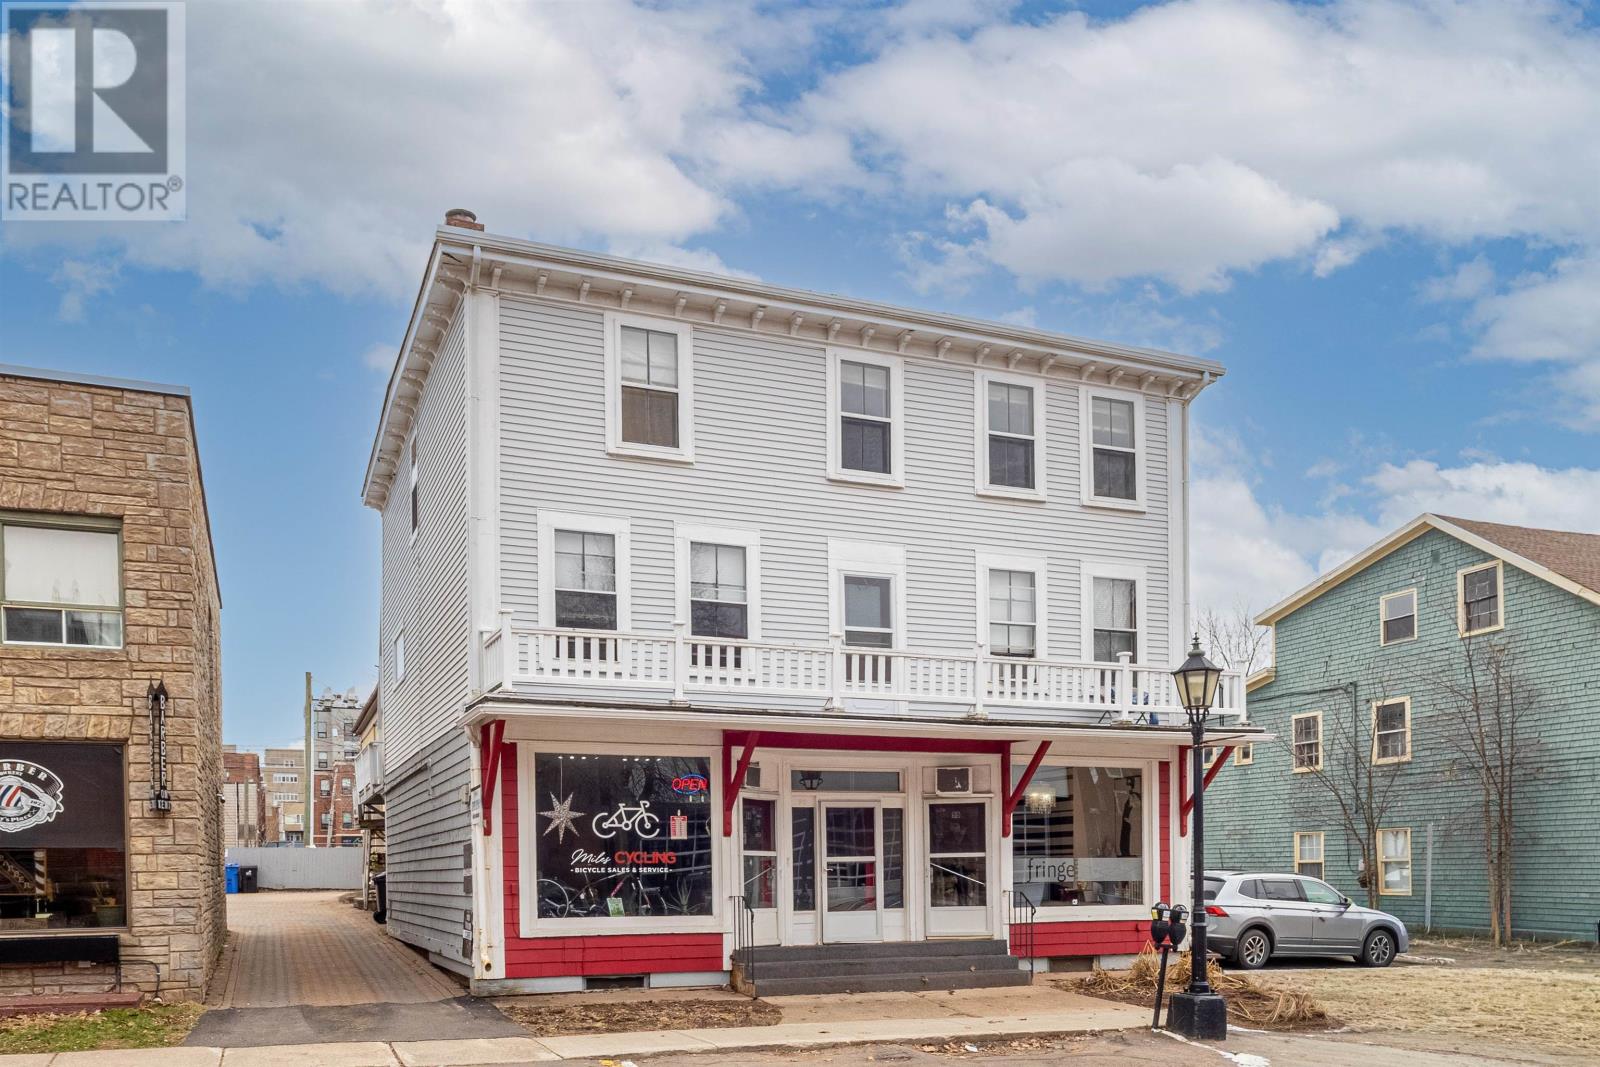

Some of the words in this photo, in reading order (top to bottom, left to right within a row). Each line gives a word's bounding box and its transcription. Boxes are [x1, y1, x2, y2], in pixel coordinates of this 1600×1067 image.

[3, 763, 47, 781] RBER
[672, 778, 709, 791] OPEN
[571, 848, 611, 865] Miles
[614, 851, 676, 864] CYCLING
[1027, 857, 1075, 883] fringe
